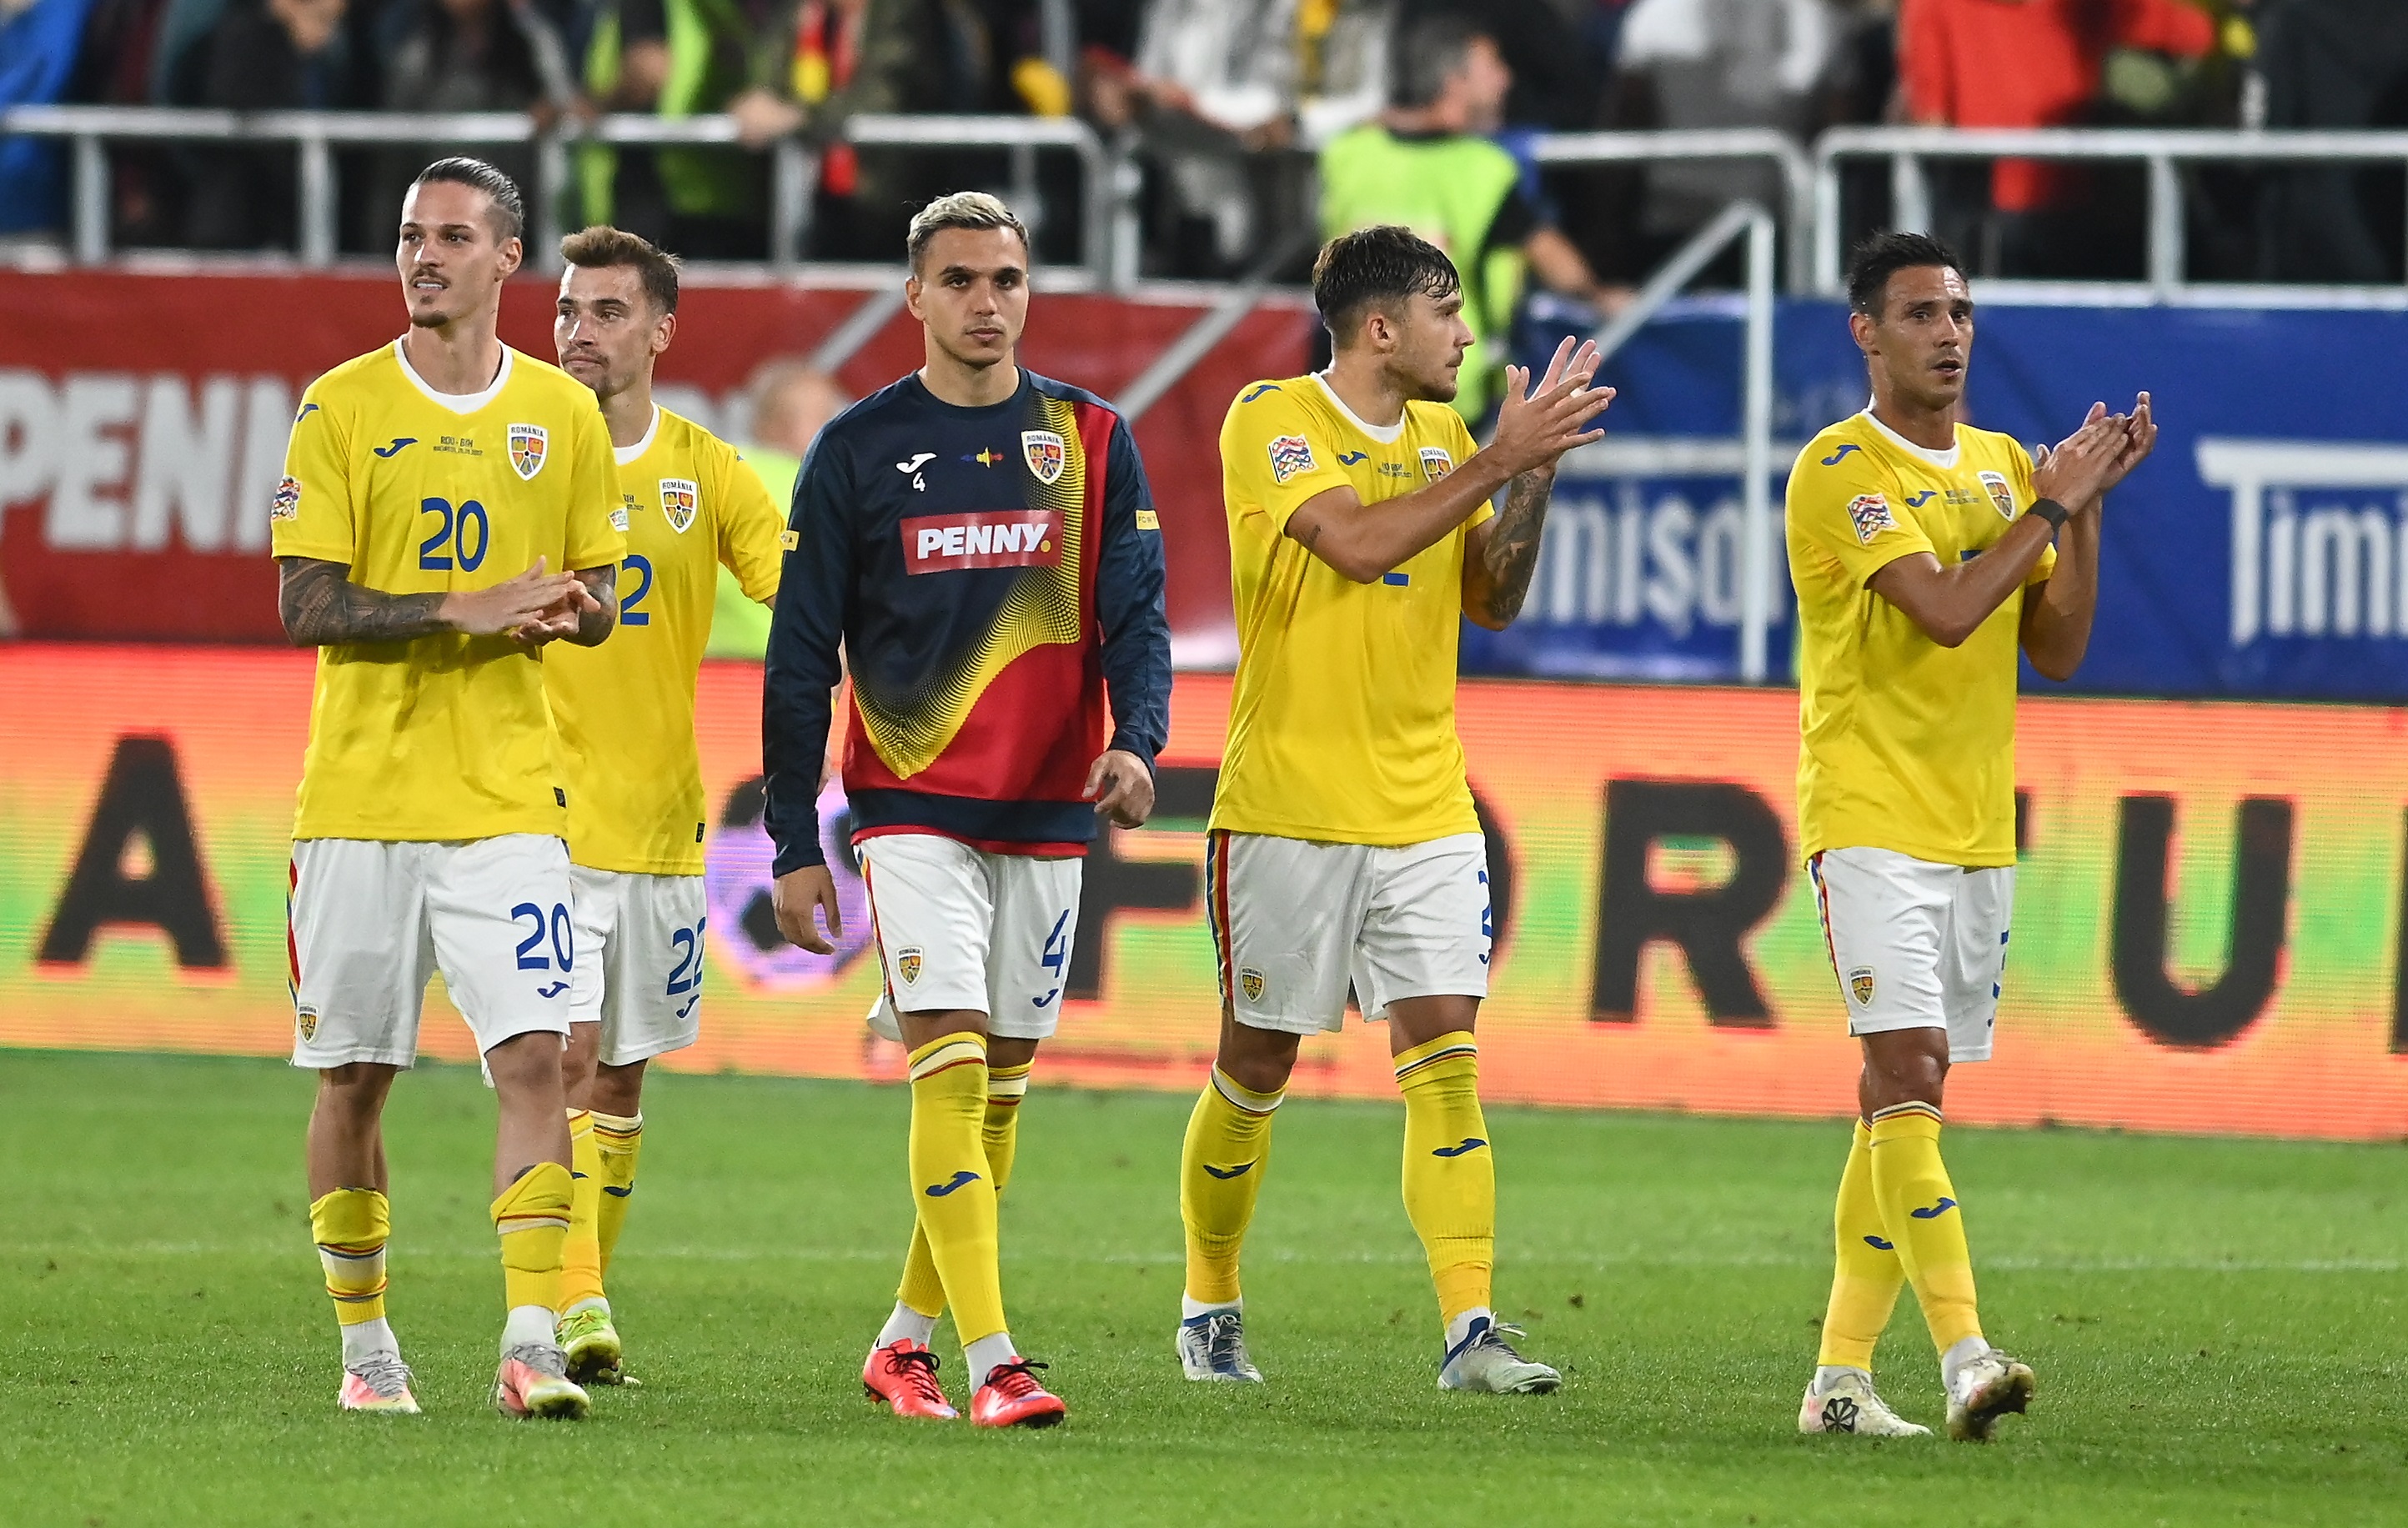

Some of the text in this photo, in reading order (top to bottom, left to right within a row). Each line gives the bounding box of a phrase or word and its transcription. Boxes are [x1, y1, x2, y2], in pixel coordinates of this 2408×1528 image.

[912, 471, 926, 492] 4
[419, 496, 490, 573] 20
[510, 901, 574, 973] 20
[1041, 908, 1071, 979] 4
